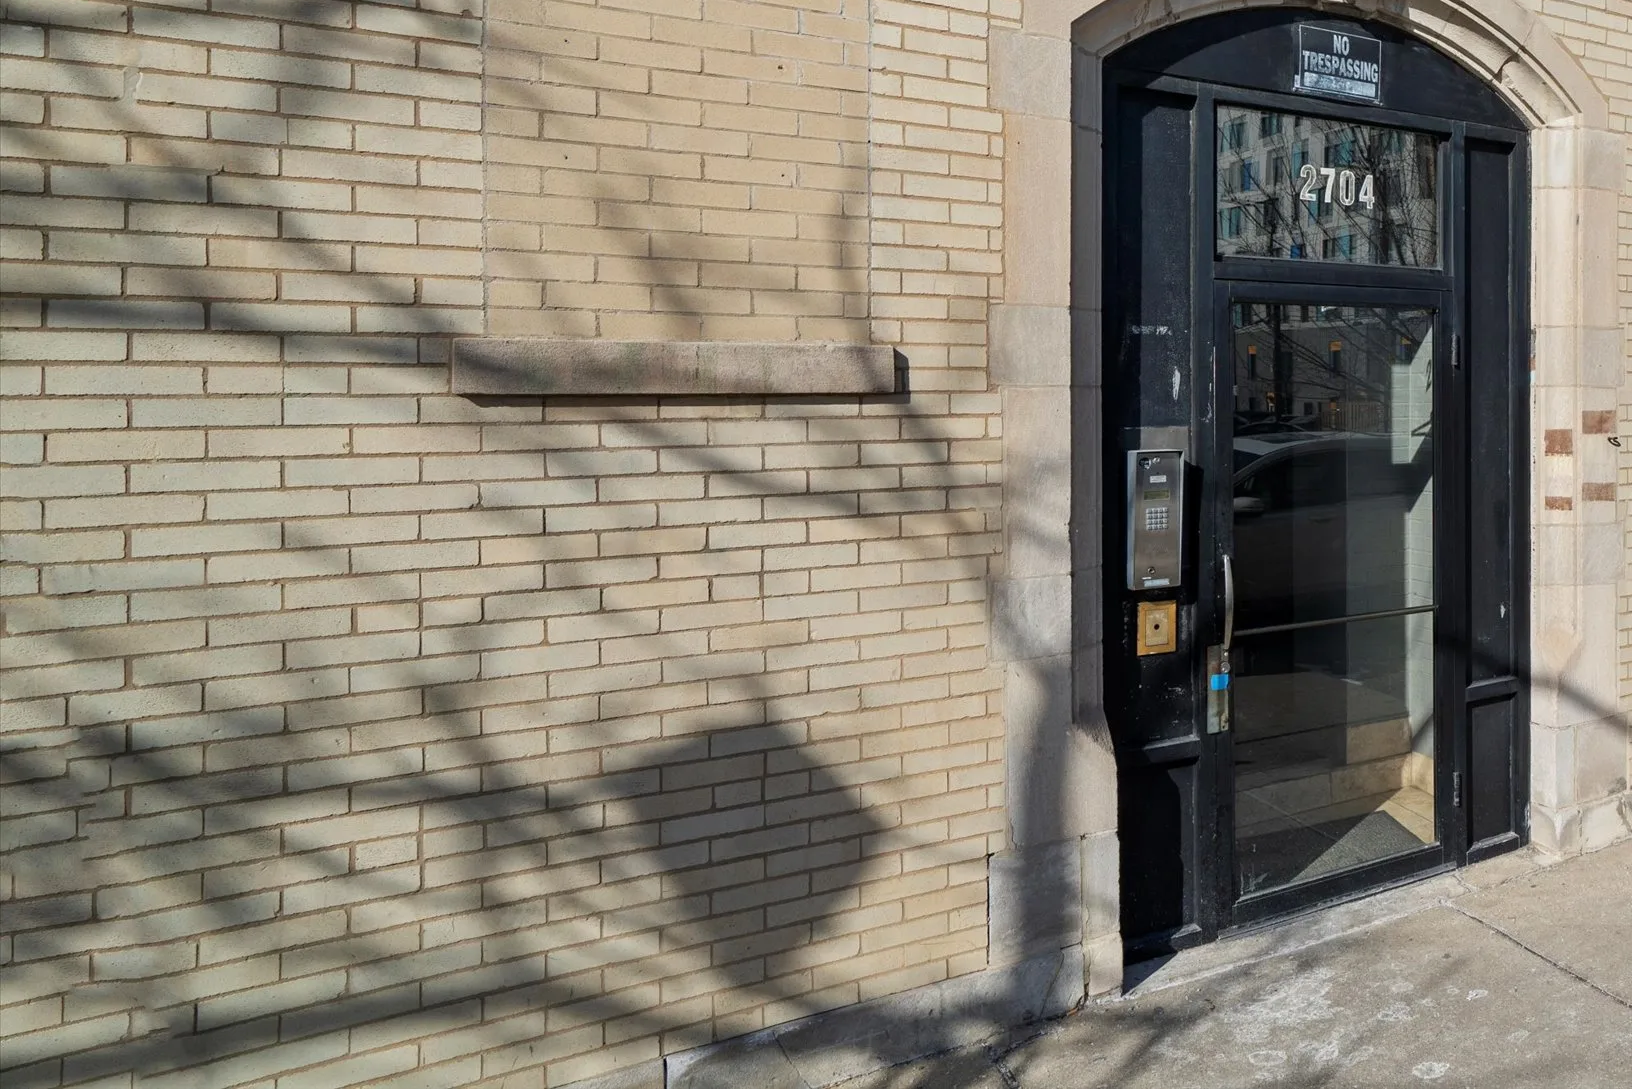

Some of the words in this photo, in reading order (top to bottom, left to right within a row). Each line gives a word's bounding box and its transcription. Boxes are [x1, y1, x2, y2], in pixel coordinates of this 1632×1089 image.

[1333, 34, 1350, 56] NO
[1303, 50, 1379, 83] TRESPASSING
[1300, 164, 1375, 209] 2704
